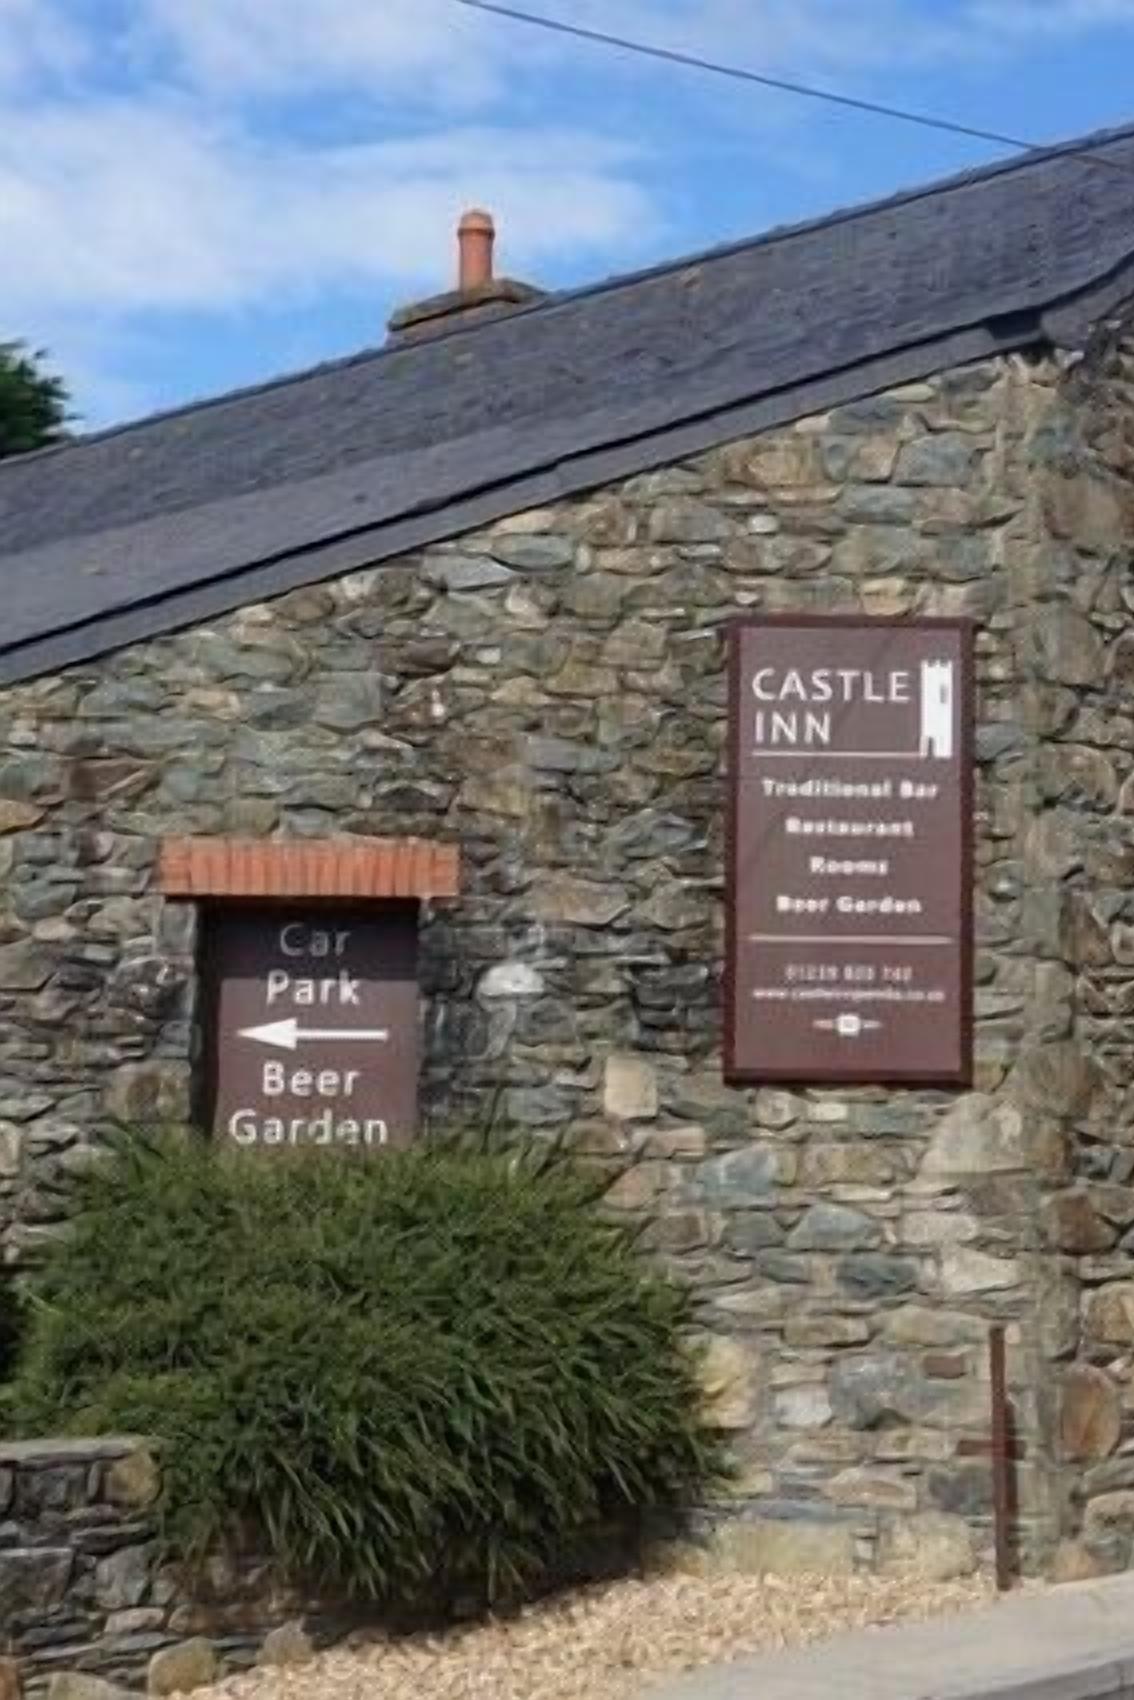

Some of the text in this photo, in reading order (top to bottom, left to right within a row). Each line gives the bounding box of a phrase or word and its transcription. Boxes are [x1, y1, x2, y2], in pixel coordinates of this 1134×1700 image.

[752, 668, 910, 703] CASTLE
[755, 711, 831, 743] INN
[762, 778, 939, 799] Traditional Bar
[785, 816, 914, 837] Restaurant
[809, 856, 889, 875] Rooms
[776, 895, 922, 913] Beer Garden
[280, 923, 350, 957] Car
[266, 968, 361, 1005] Park
[262, 1060, 361, 1096] Beer
[228, 1108, 389, 1145] Garden
